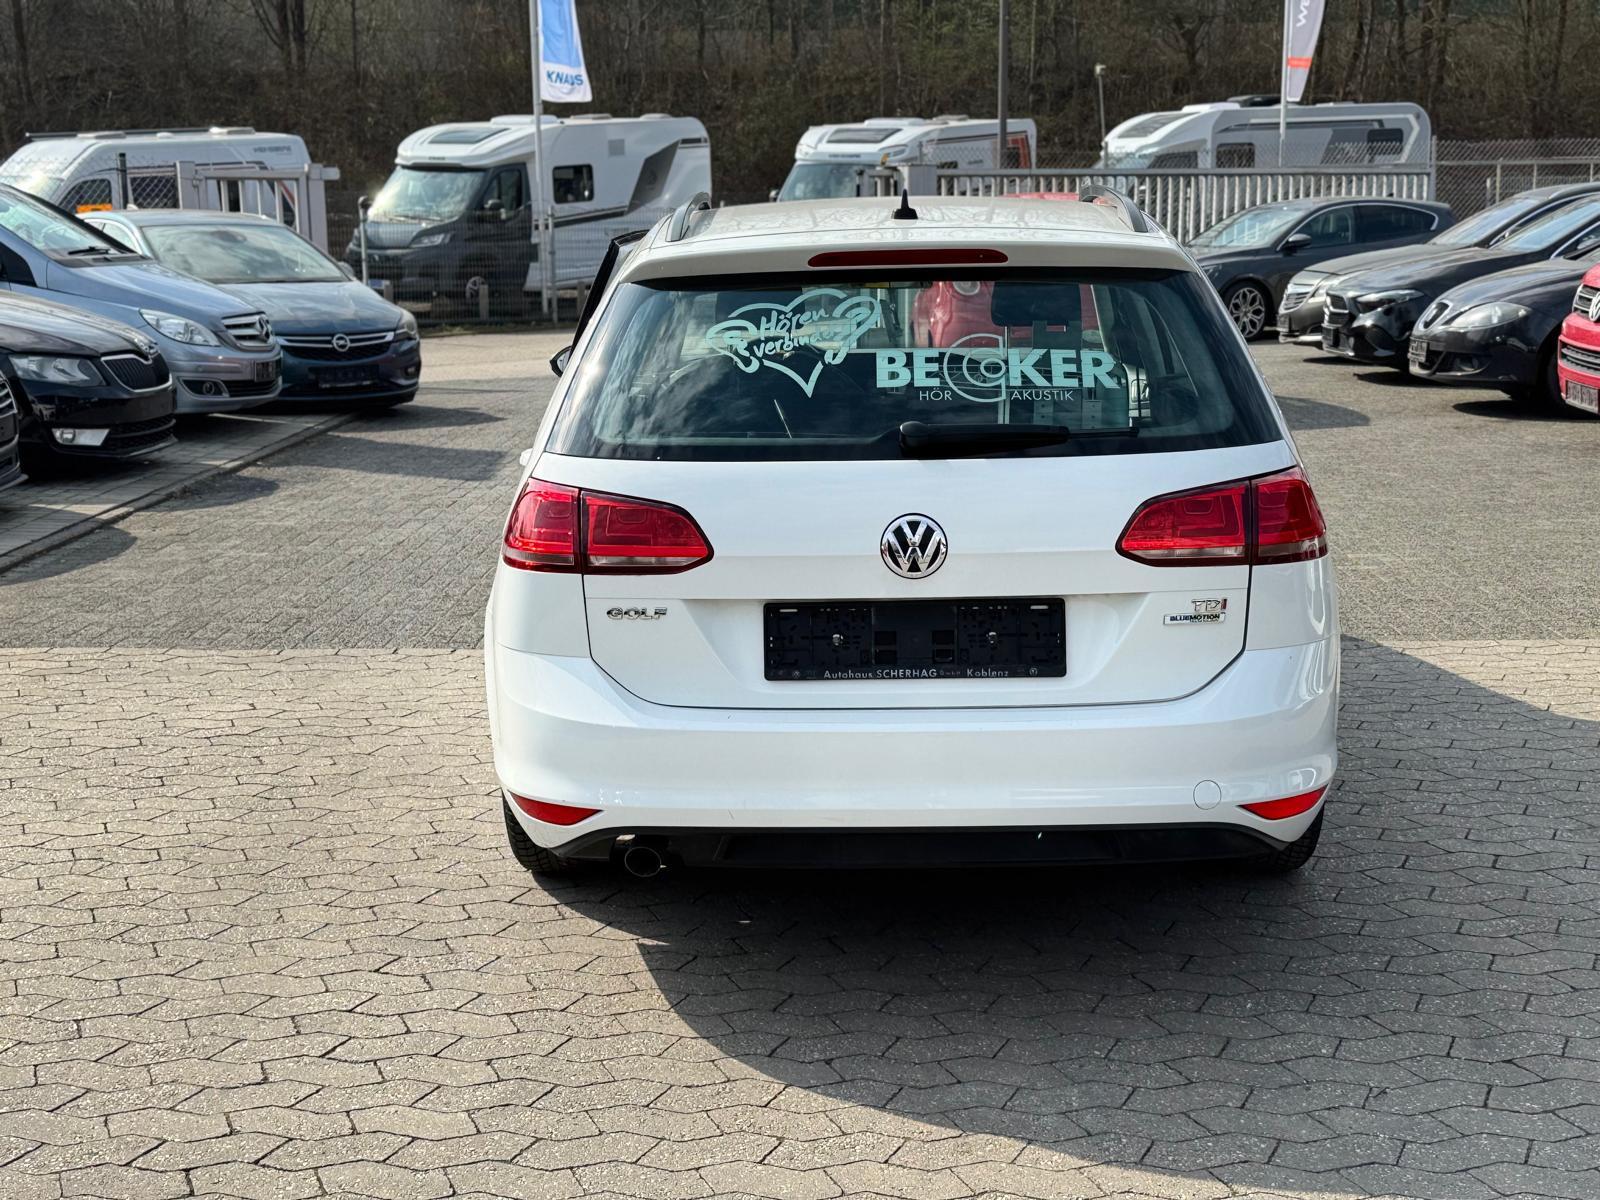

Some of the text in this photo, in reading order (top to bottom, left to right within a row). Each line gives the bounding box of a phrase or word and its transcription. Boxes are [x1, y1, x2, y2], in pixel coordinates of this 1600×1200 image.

[546, 70, 584, 86] KNAUS
[760, 308, 829, 341] Hören
[753, 321, 843, 358] verbinde
[919, 388, 952, 401] HÖR
[1011, 390, 1074, 401] AKUSTIK
[606, 607, 667, 620] GOLF
[1169, 613, 1220, 621] BLUEMOTION
[823, 669, 874, 679] Autohaus
[876, 669, 937, 678] SCHERHAG
[966, 668, 1009, 678] Koblenz
